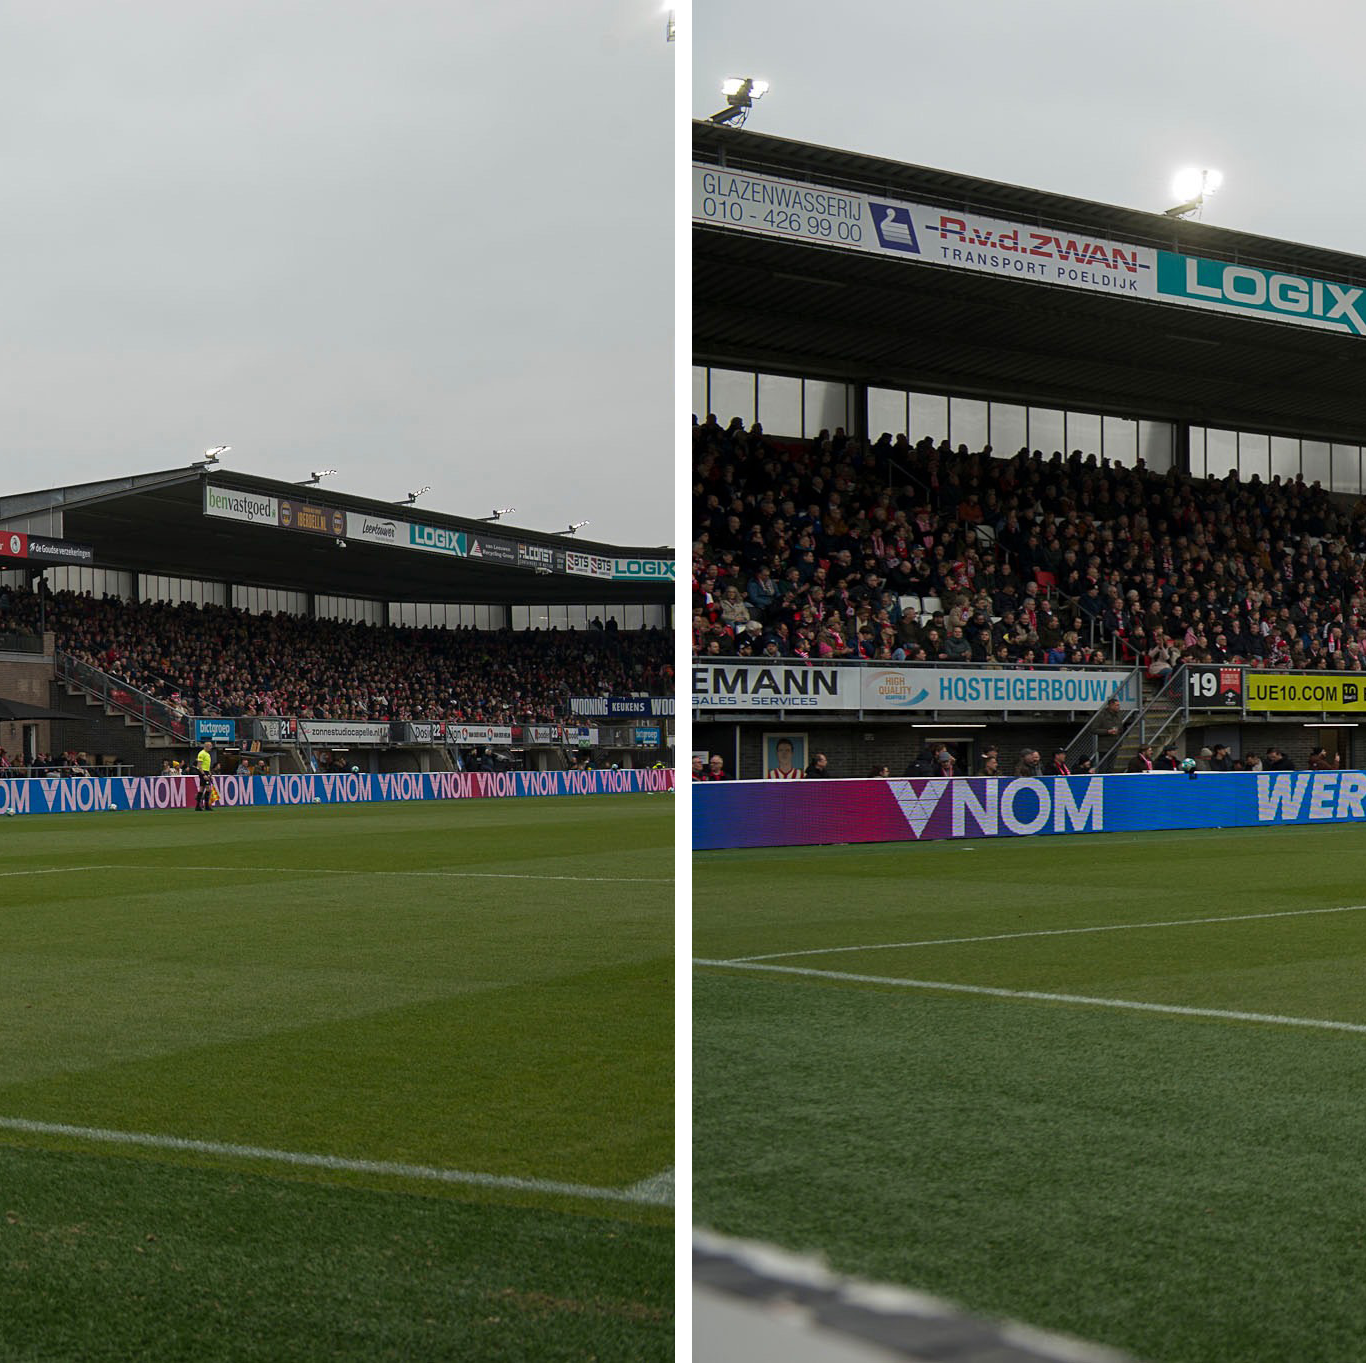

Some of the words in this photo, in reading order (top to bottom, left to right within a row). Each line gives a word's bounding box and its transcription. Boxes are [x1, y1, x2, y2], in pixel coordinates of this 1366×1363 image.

[703, 173, 861, 221] GLAZENWASSERIJ
[703, 198, 743, 221] 010
[763, 209, 801, 231] 426
[807, 216, 832, 237] 99
[837, 222, 862, 242] 00
[941, 246, 1047, 275] TRANSPORT
[1057, 267, 1138, 291] POELDIJK
[209, 487, 271, 520] benvastgoed
[414, 525, 464, 557] LOGIX
[692, 668, 838, 695] EMANN
[878, 686, 911, 695] QUALITY
[885, 677, 905, 685] HIGH
[1190, 672, 1217, 697] 19
[571, 697, 608, 715] WOONING
[612, 702, 645, 712] KEUKENS
[752, 697, 818, 706] SERVICES
[199, 720, 230, 737] bictgroep
[281, 720, 290, 735] 21
[433, 724, 441, 736] 22
[122, 776, 185, 809] VNOM
[886, 777, 1103, 839] VNOM
